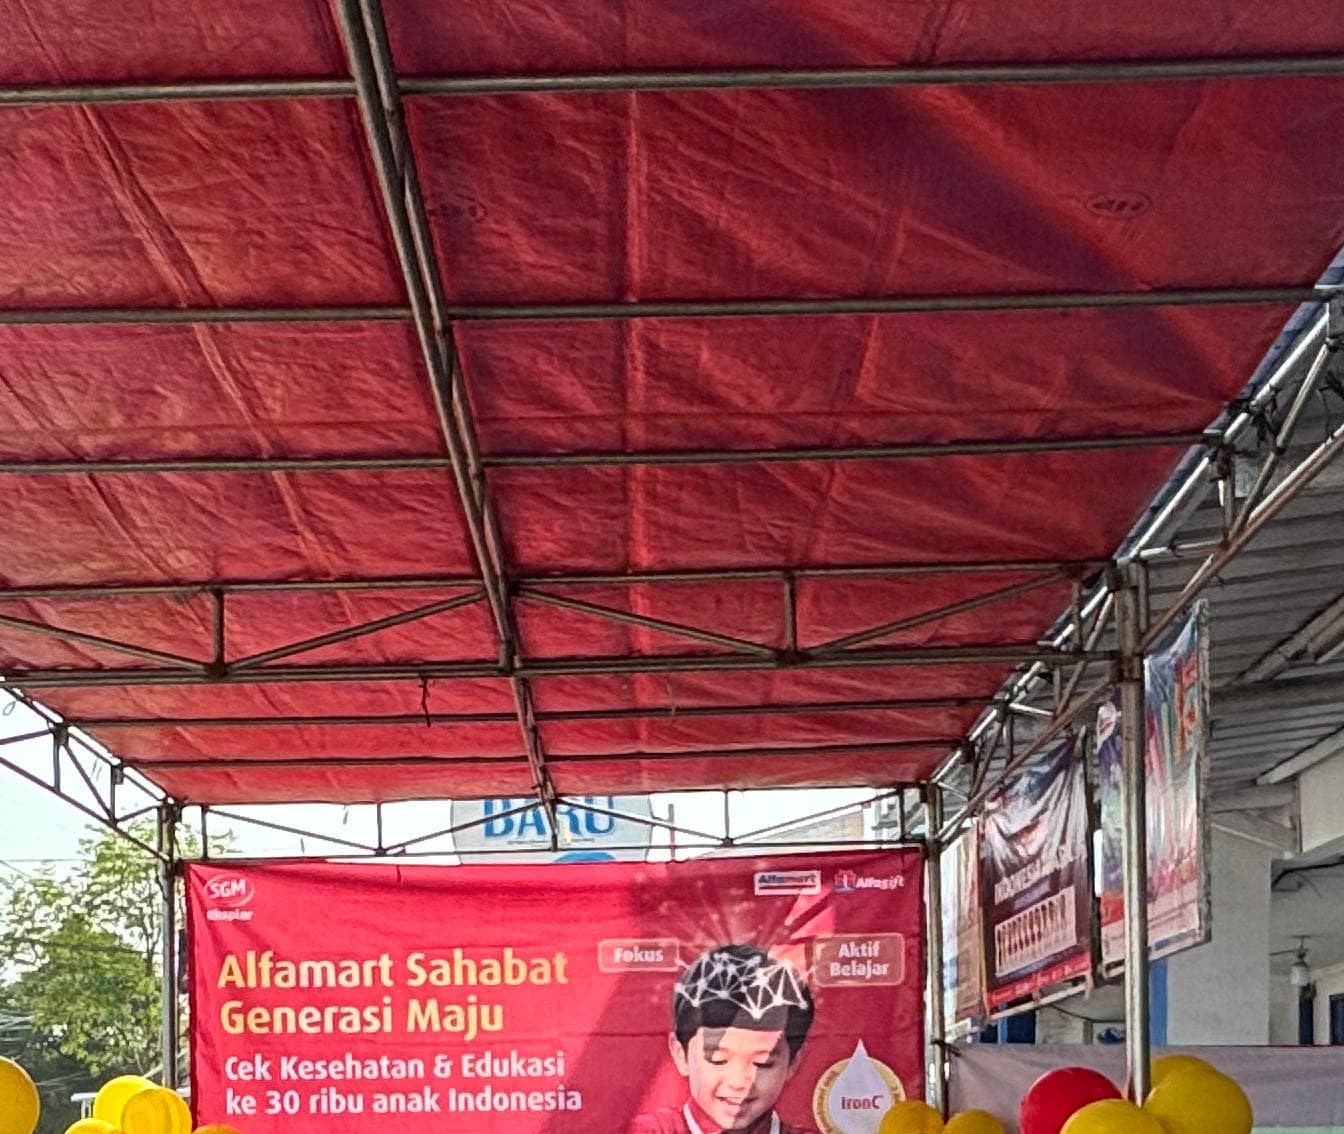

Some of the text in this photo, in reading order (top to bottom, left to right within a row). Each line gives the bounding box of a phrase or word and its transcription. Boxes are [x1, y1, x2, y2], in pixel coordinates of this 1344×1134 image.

[208, 879, 246, 898] SGM
[613, 946, 664, 964] Fokus
[838, 940, 880, 958] Aktif
[217, 947, 568, 988] Alfamart Sahabat
[829, 962, 889, 980] Belajar
[220, 994, 504, 1041] Generasi Maju
[225, 1050, 565, 1081] Cek Kesehatan & Edukasi
[226, 1084, 582, 1115] ke 30 ribu anak Indonesia
[841, 1095, 884, 1110] IronC
